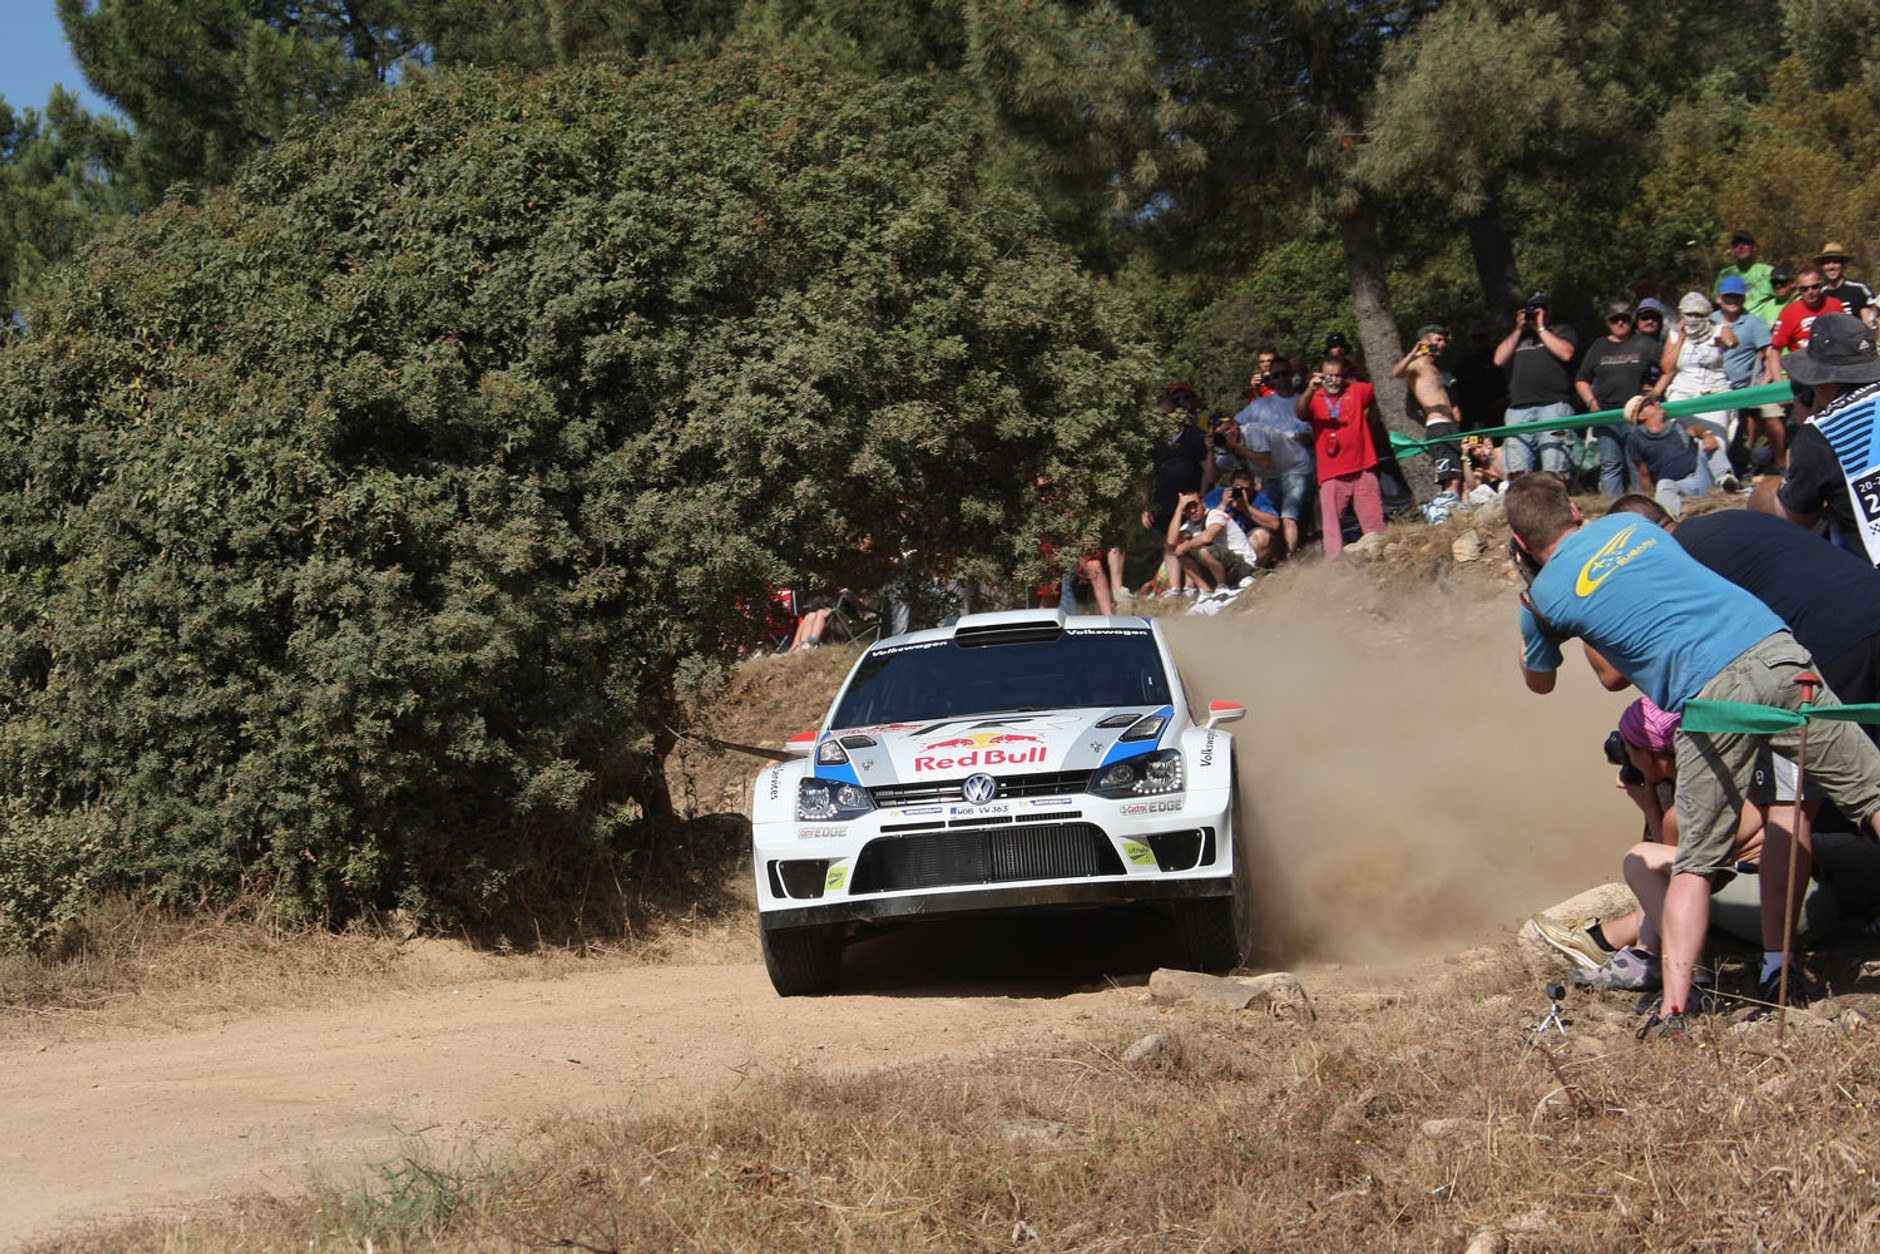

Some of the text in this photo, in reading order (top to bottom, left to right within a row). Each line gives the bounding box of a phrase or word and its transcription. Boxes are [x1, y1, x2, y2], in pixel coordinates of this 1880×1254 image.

[1066, 628, 1148, 637] Volkswagen
[872, 641, 948, 657] Volkswagen
[915, 747, 1047, 772] Red Bull
[1149, 800, 1183, 812] EDGE
[814, 826, 849, 838] EDGE
